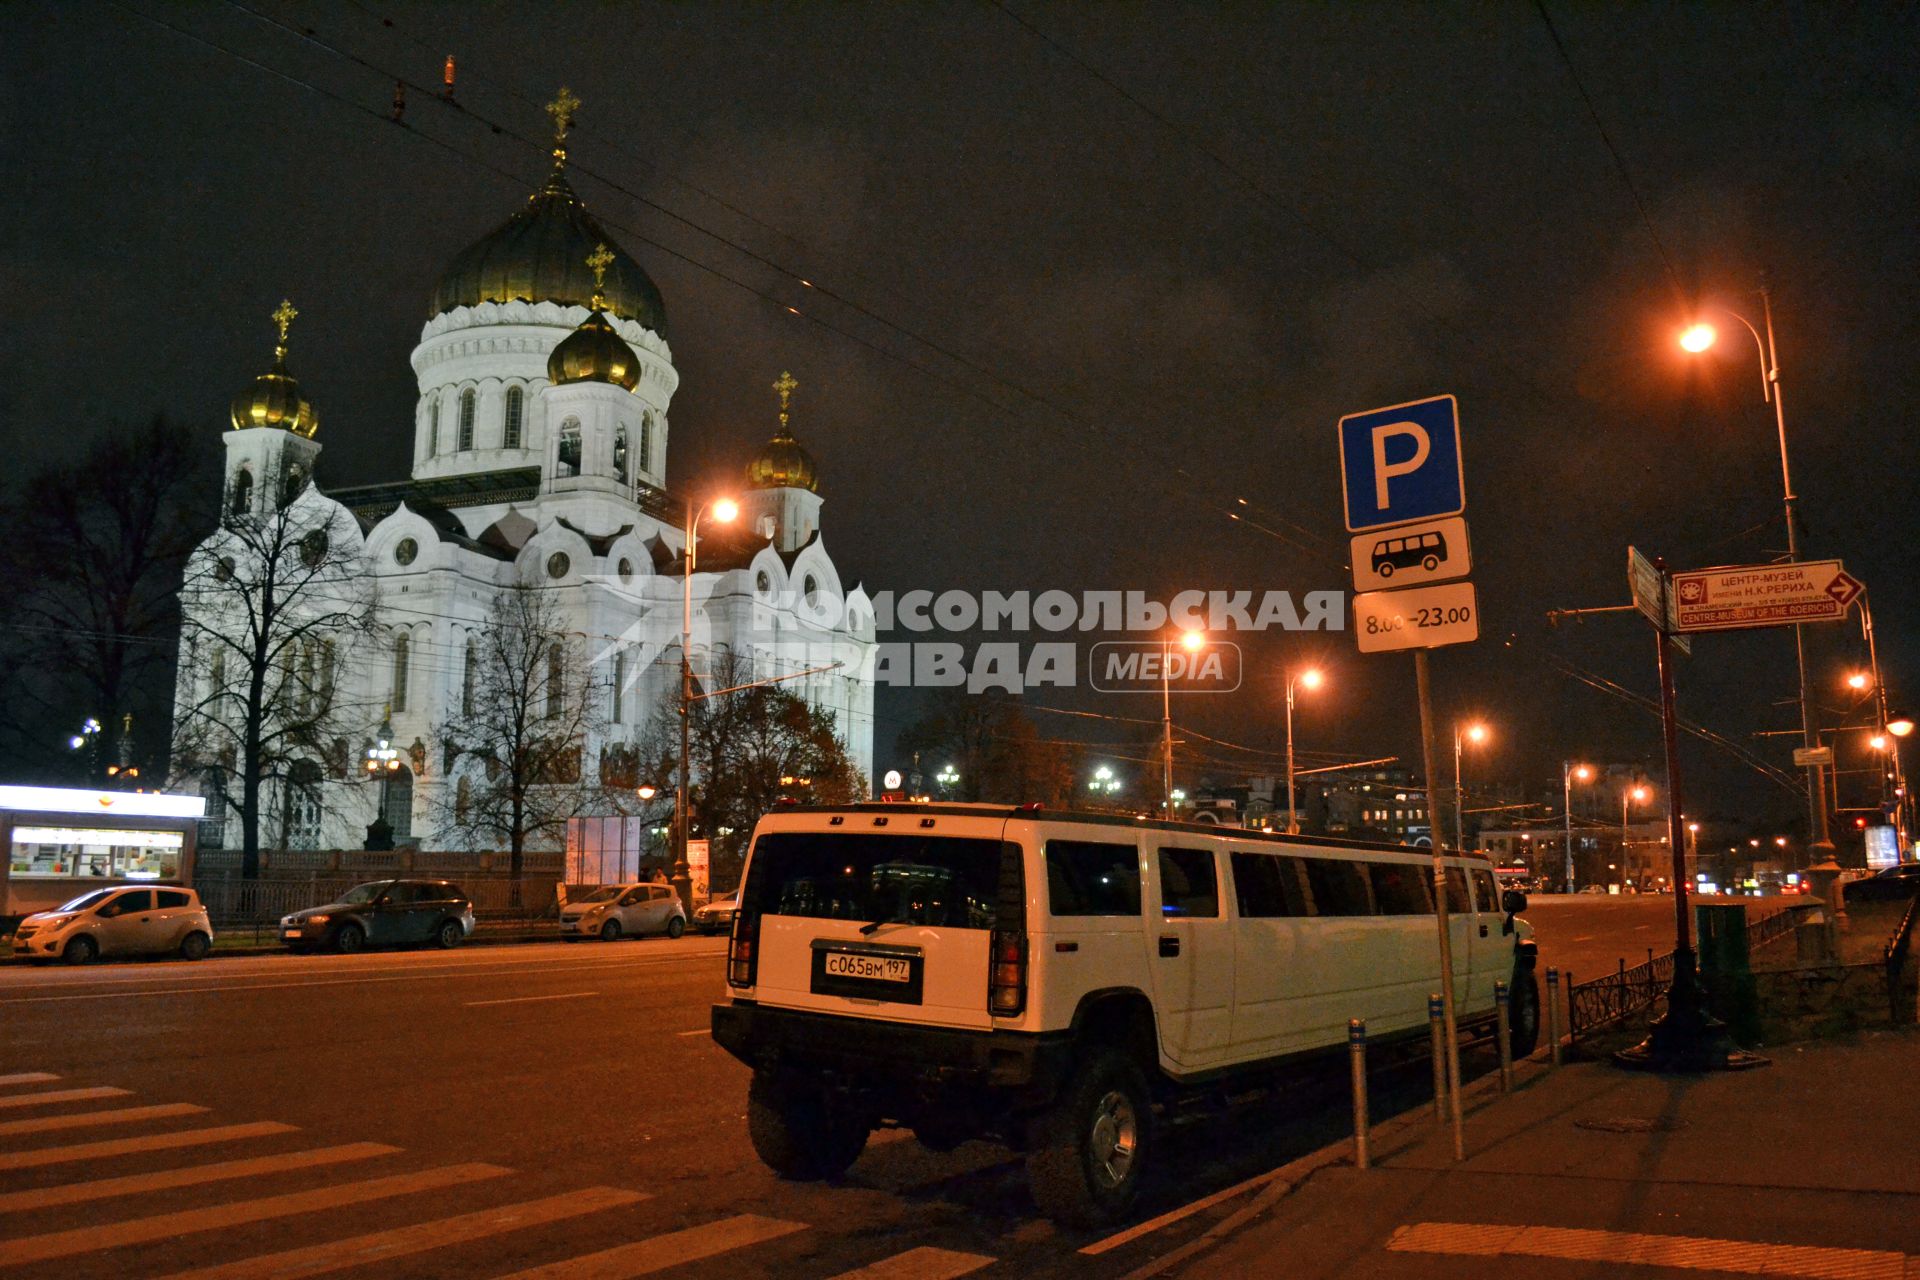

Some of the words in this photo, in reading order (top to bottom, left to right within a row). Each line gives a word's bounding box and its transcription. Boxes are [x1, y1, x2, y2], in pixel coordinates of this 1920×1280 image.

[1371, 421, 1431, 510] P
[1720, 570, 1804, 587] ЦЕНТР-МУЗЕЙ
[1681, 608, 1755, 624] CENTRE-MUSEUM
[1756, 607, 1769, 618] OF
[1770, 605, 1788, 617] THE
[1789, 601, 1836, 615] ROERICHS
